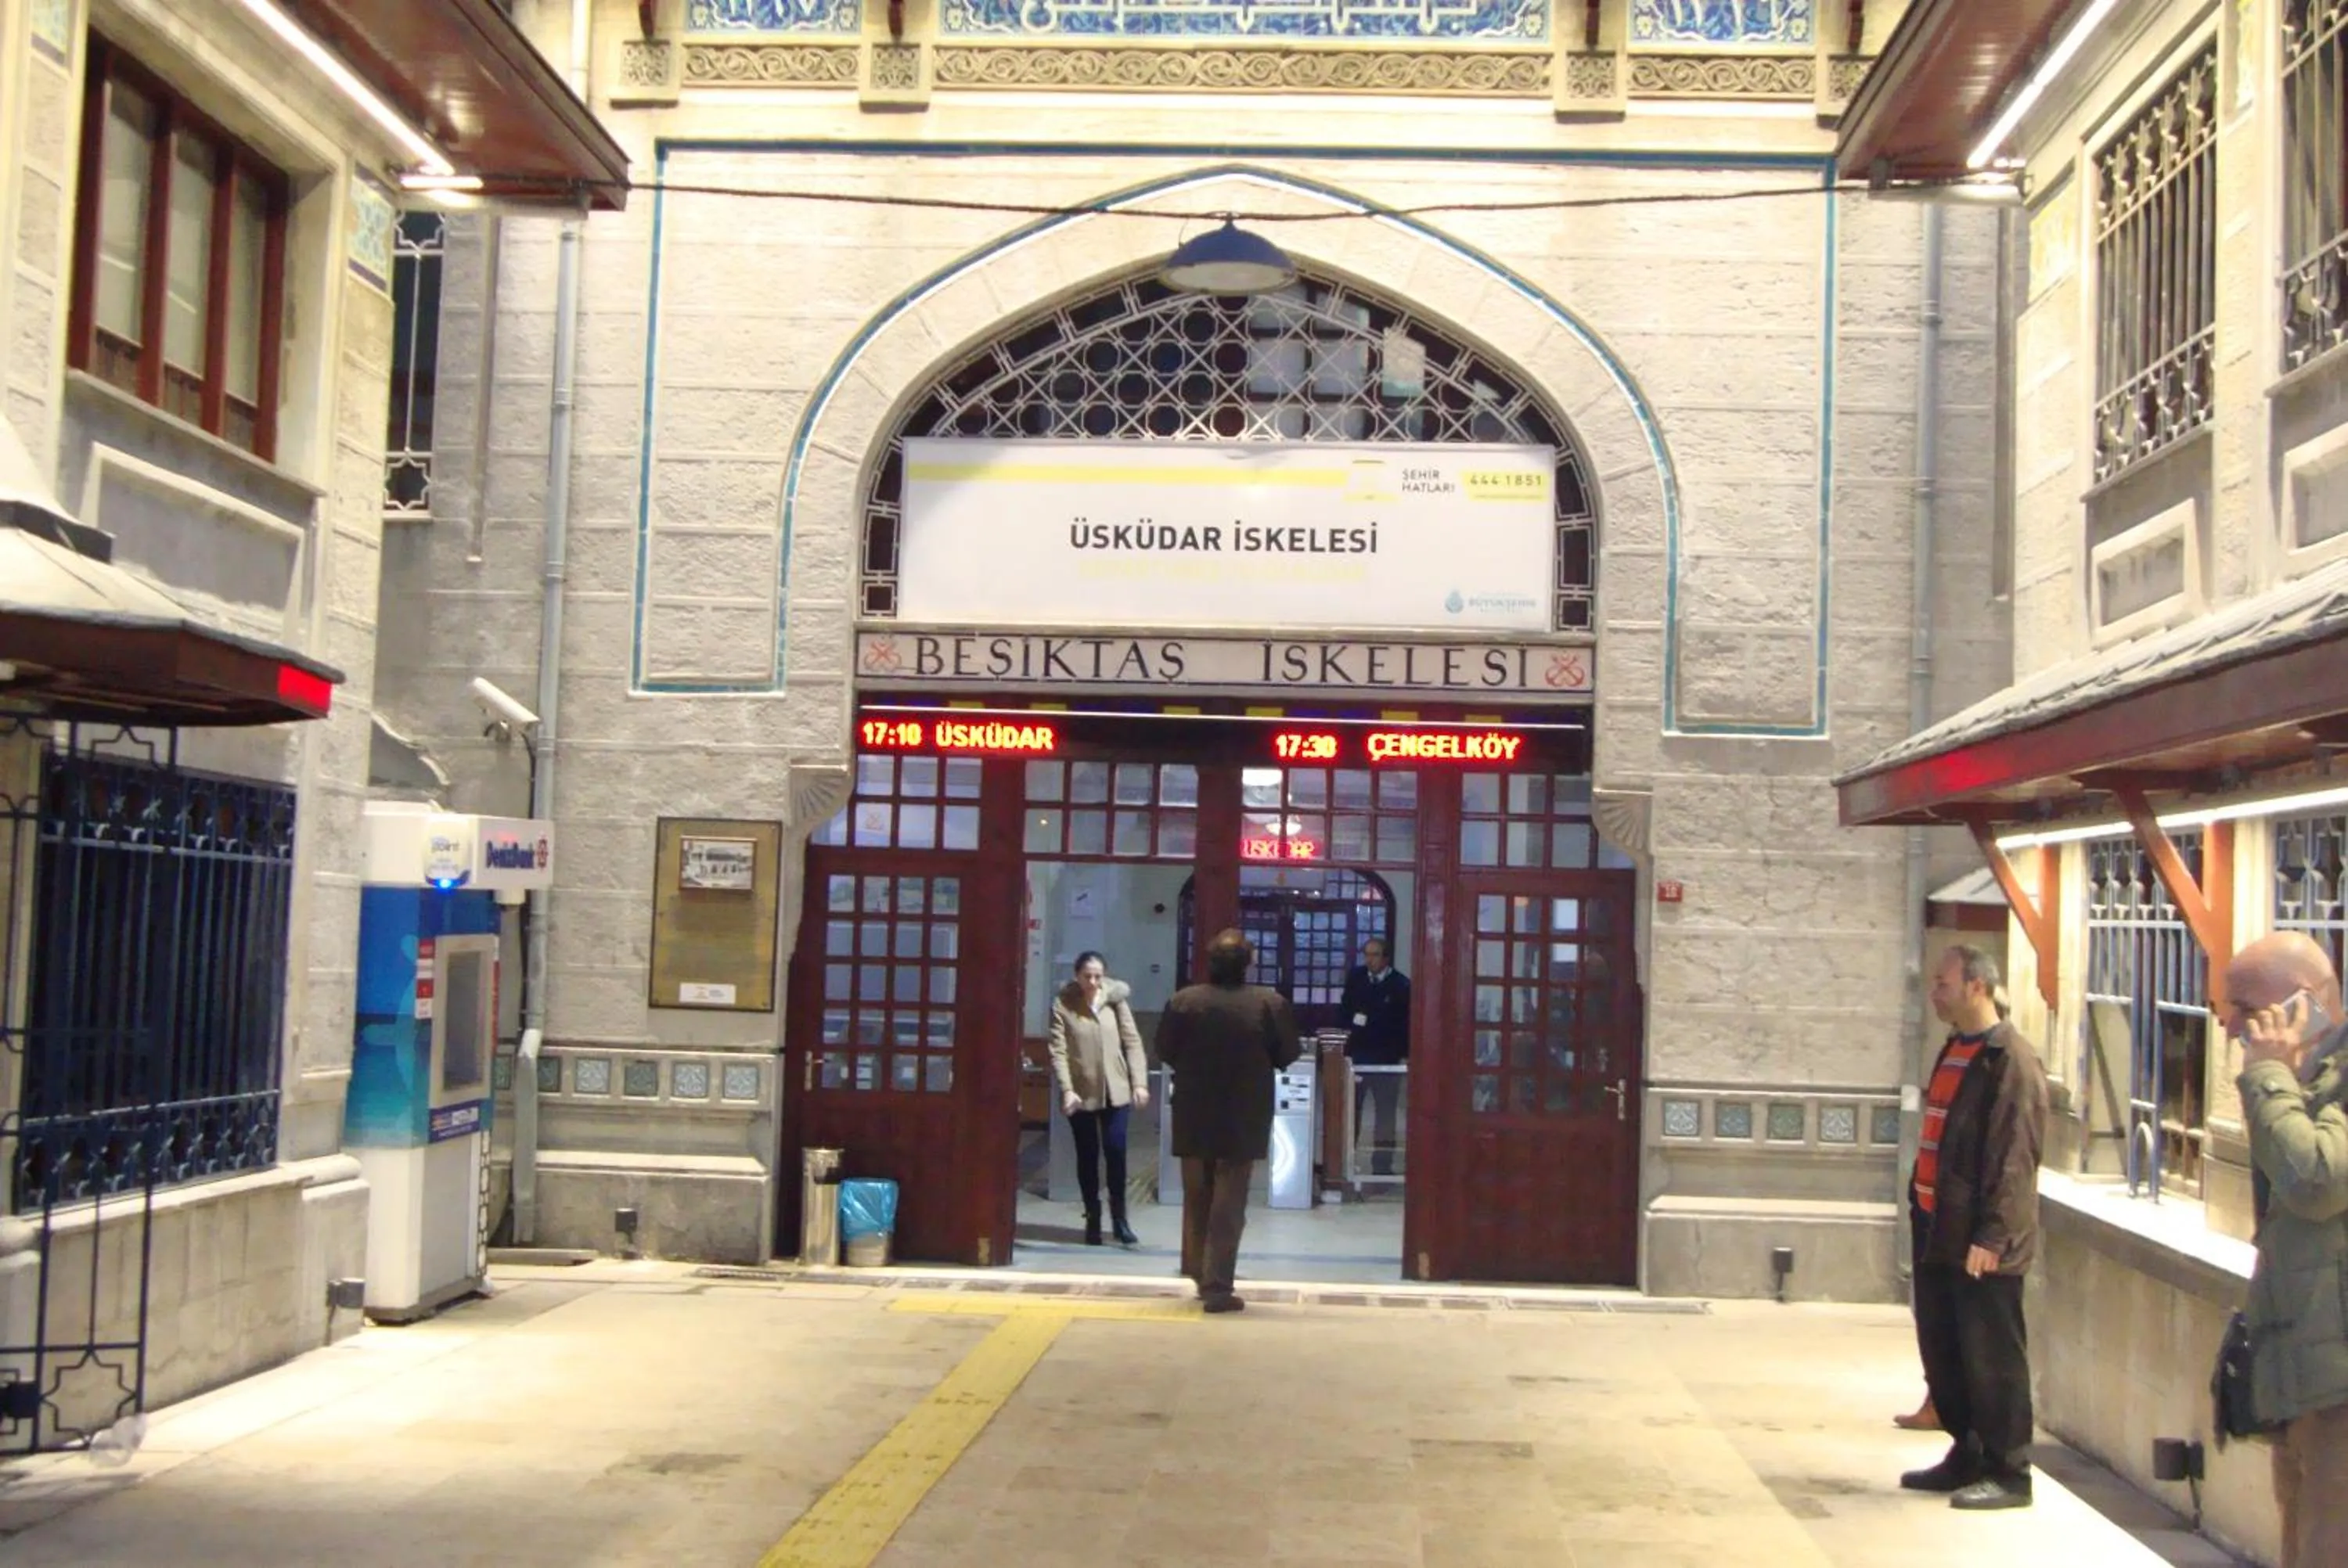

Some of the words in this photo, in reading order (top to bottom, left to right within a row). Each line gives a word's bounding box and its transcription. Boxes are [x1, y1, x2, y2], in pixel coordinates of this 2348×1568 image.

[1401, 468, 1441, 482] ŞEHİR
[1401, 481, 1456, 494] HATLARI
[1469, 473, 1500, 487] 444
[1505, 474, 1543, 487] 1851
[1070, 517, 1223, 552] ÜSKÜDAR
[1233, 520, 1379, 554] İSKELESİ
[915, 635, 1187, 685] BEŞİKTAŞ
[1262, 638, 1529, 688] İSKELESİ
[862, 721, 923, 746] 17:10
[935, 720, 1054, 750] ÜSKÜDAR
[1275, 733, 1338, 759] 17:30
[1367, 732, 1522, 761] ÇENGELKÖY
